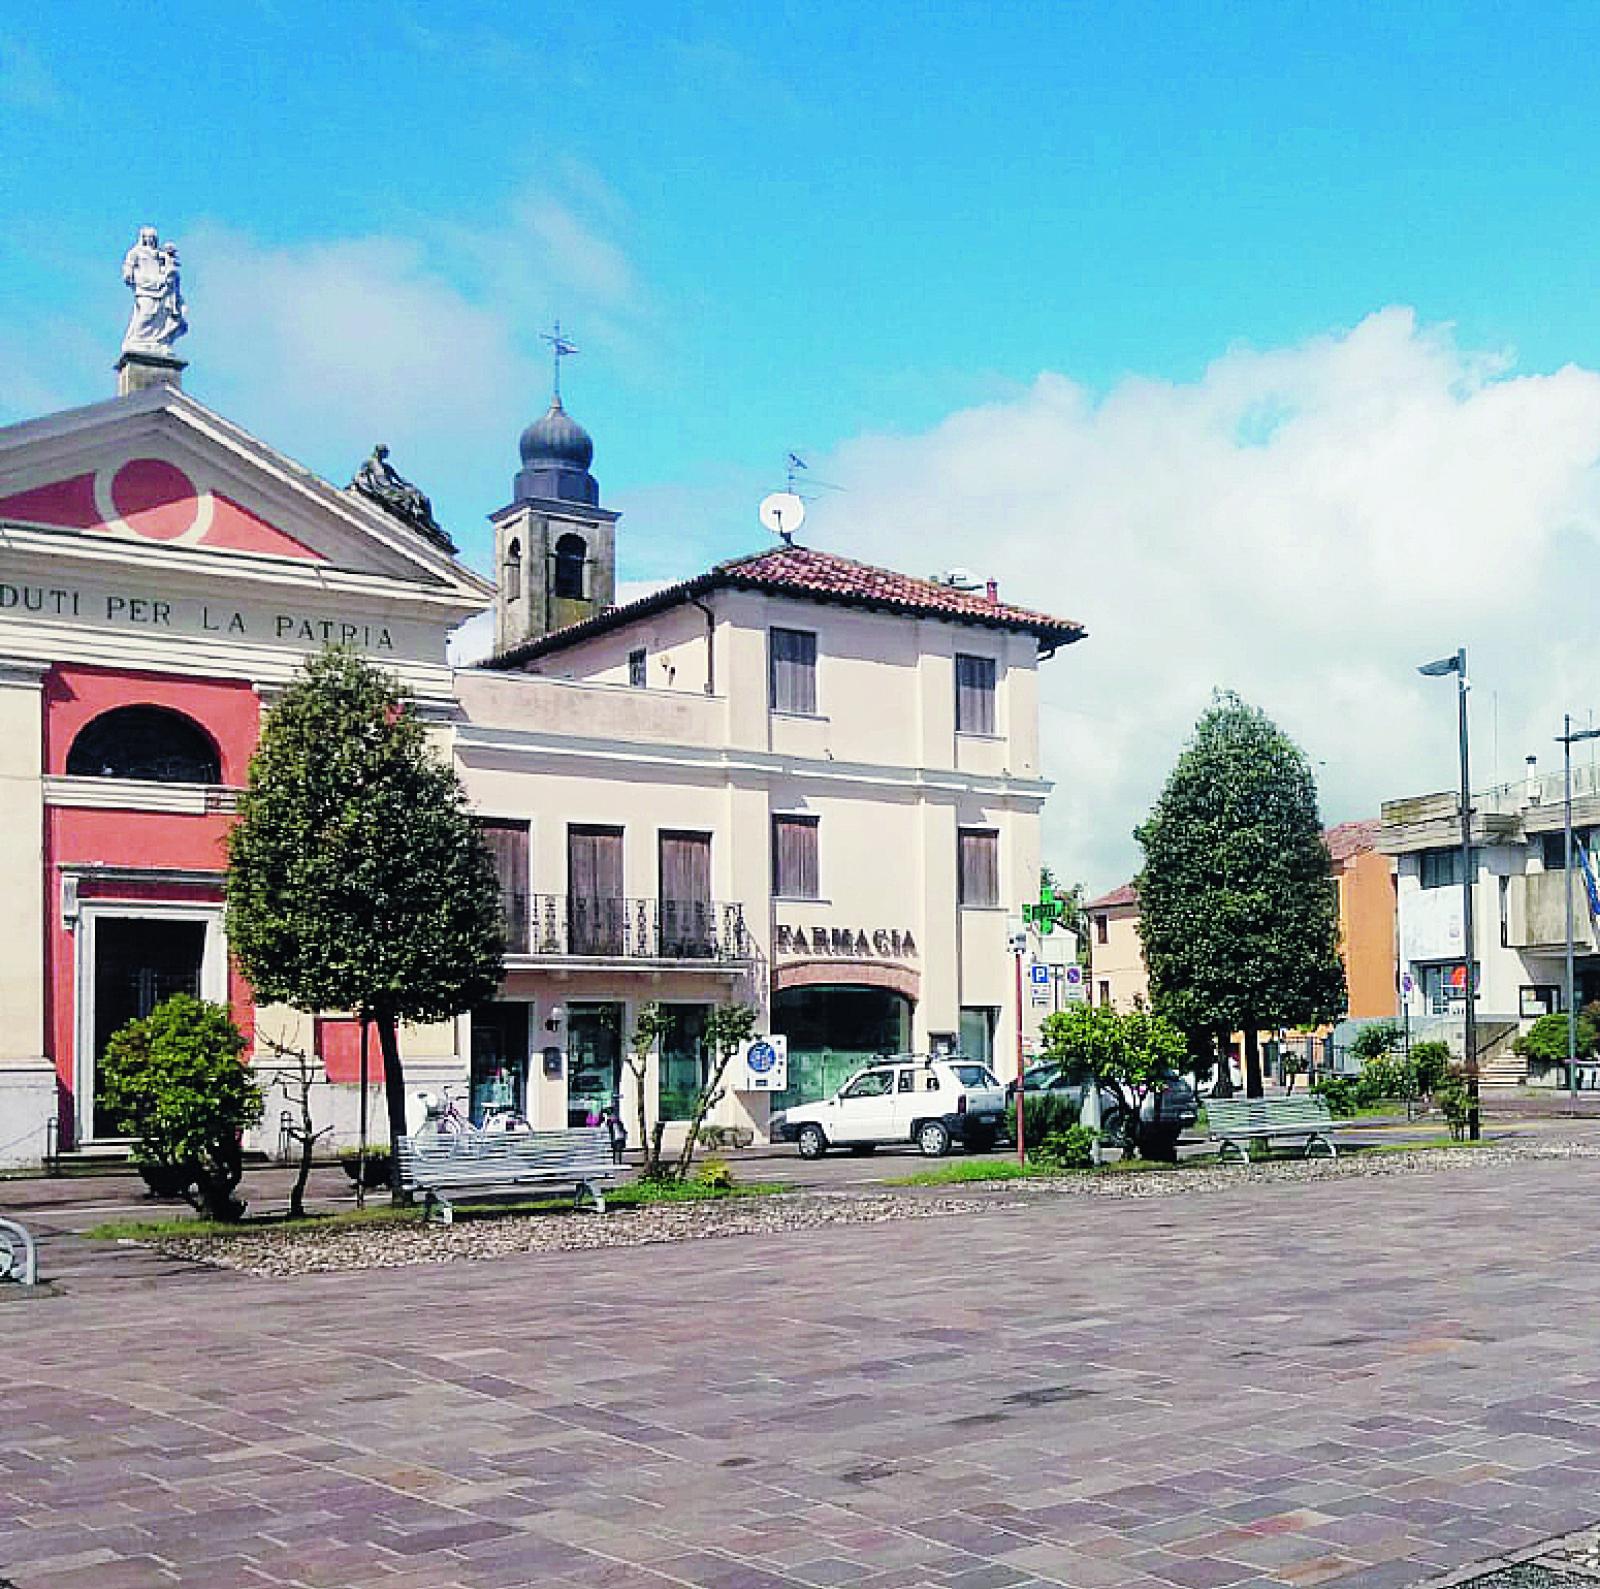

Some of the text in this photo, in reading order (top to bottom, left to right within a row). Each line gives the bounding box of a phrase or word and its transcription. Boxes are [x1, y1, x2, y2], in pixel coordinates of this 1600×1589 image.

[0, 583, 393, 649] DUTI PER LA PATRIA
[777, 924, 918, 957] FARMACIA
